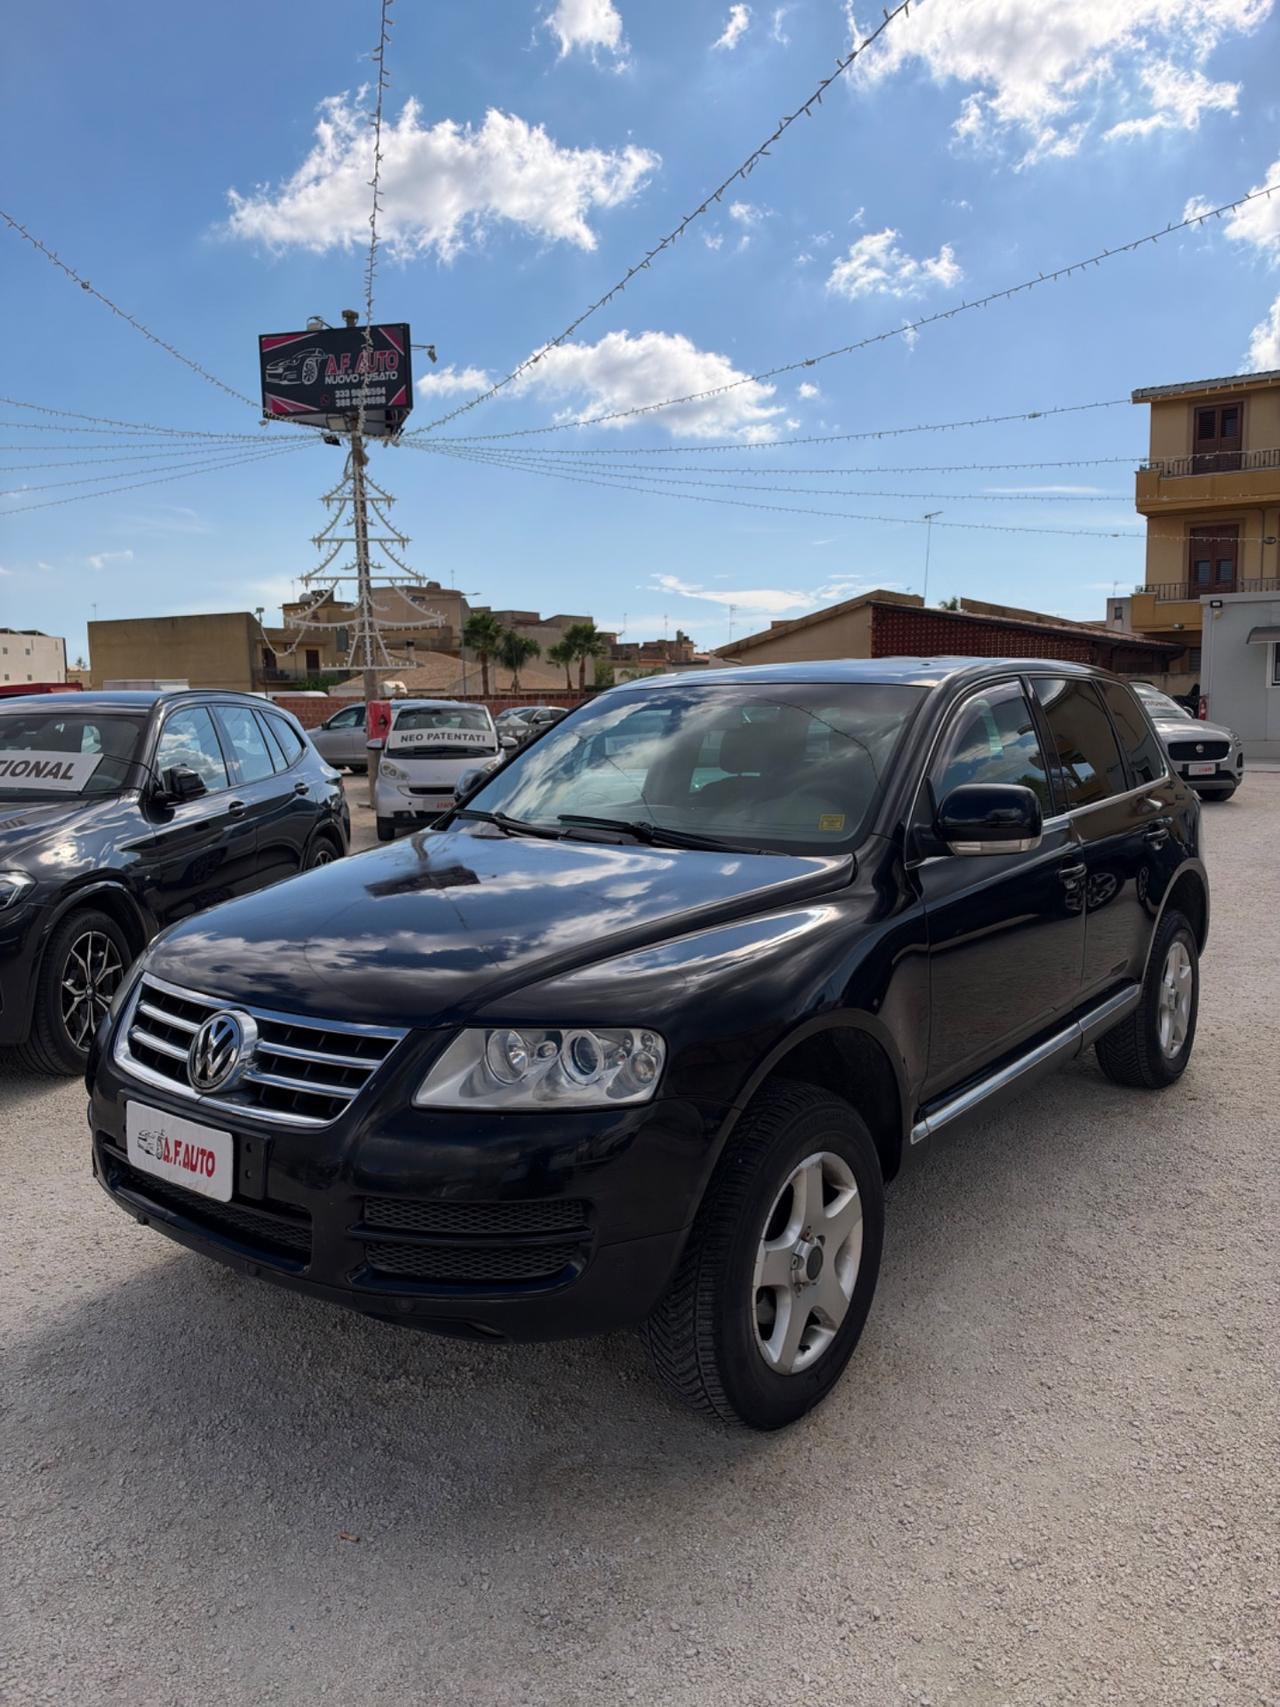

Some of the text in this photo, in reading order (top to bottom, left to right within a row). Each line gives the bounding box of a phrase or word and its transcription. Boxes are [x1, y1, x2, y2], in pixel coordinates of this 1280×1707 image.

[325, 349, 399, 376] A.F. AUTO
[325, 374, 360, 385] NUOVO
[400, 732, 486, 743] NEO PATENTATI
